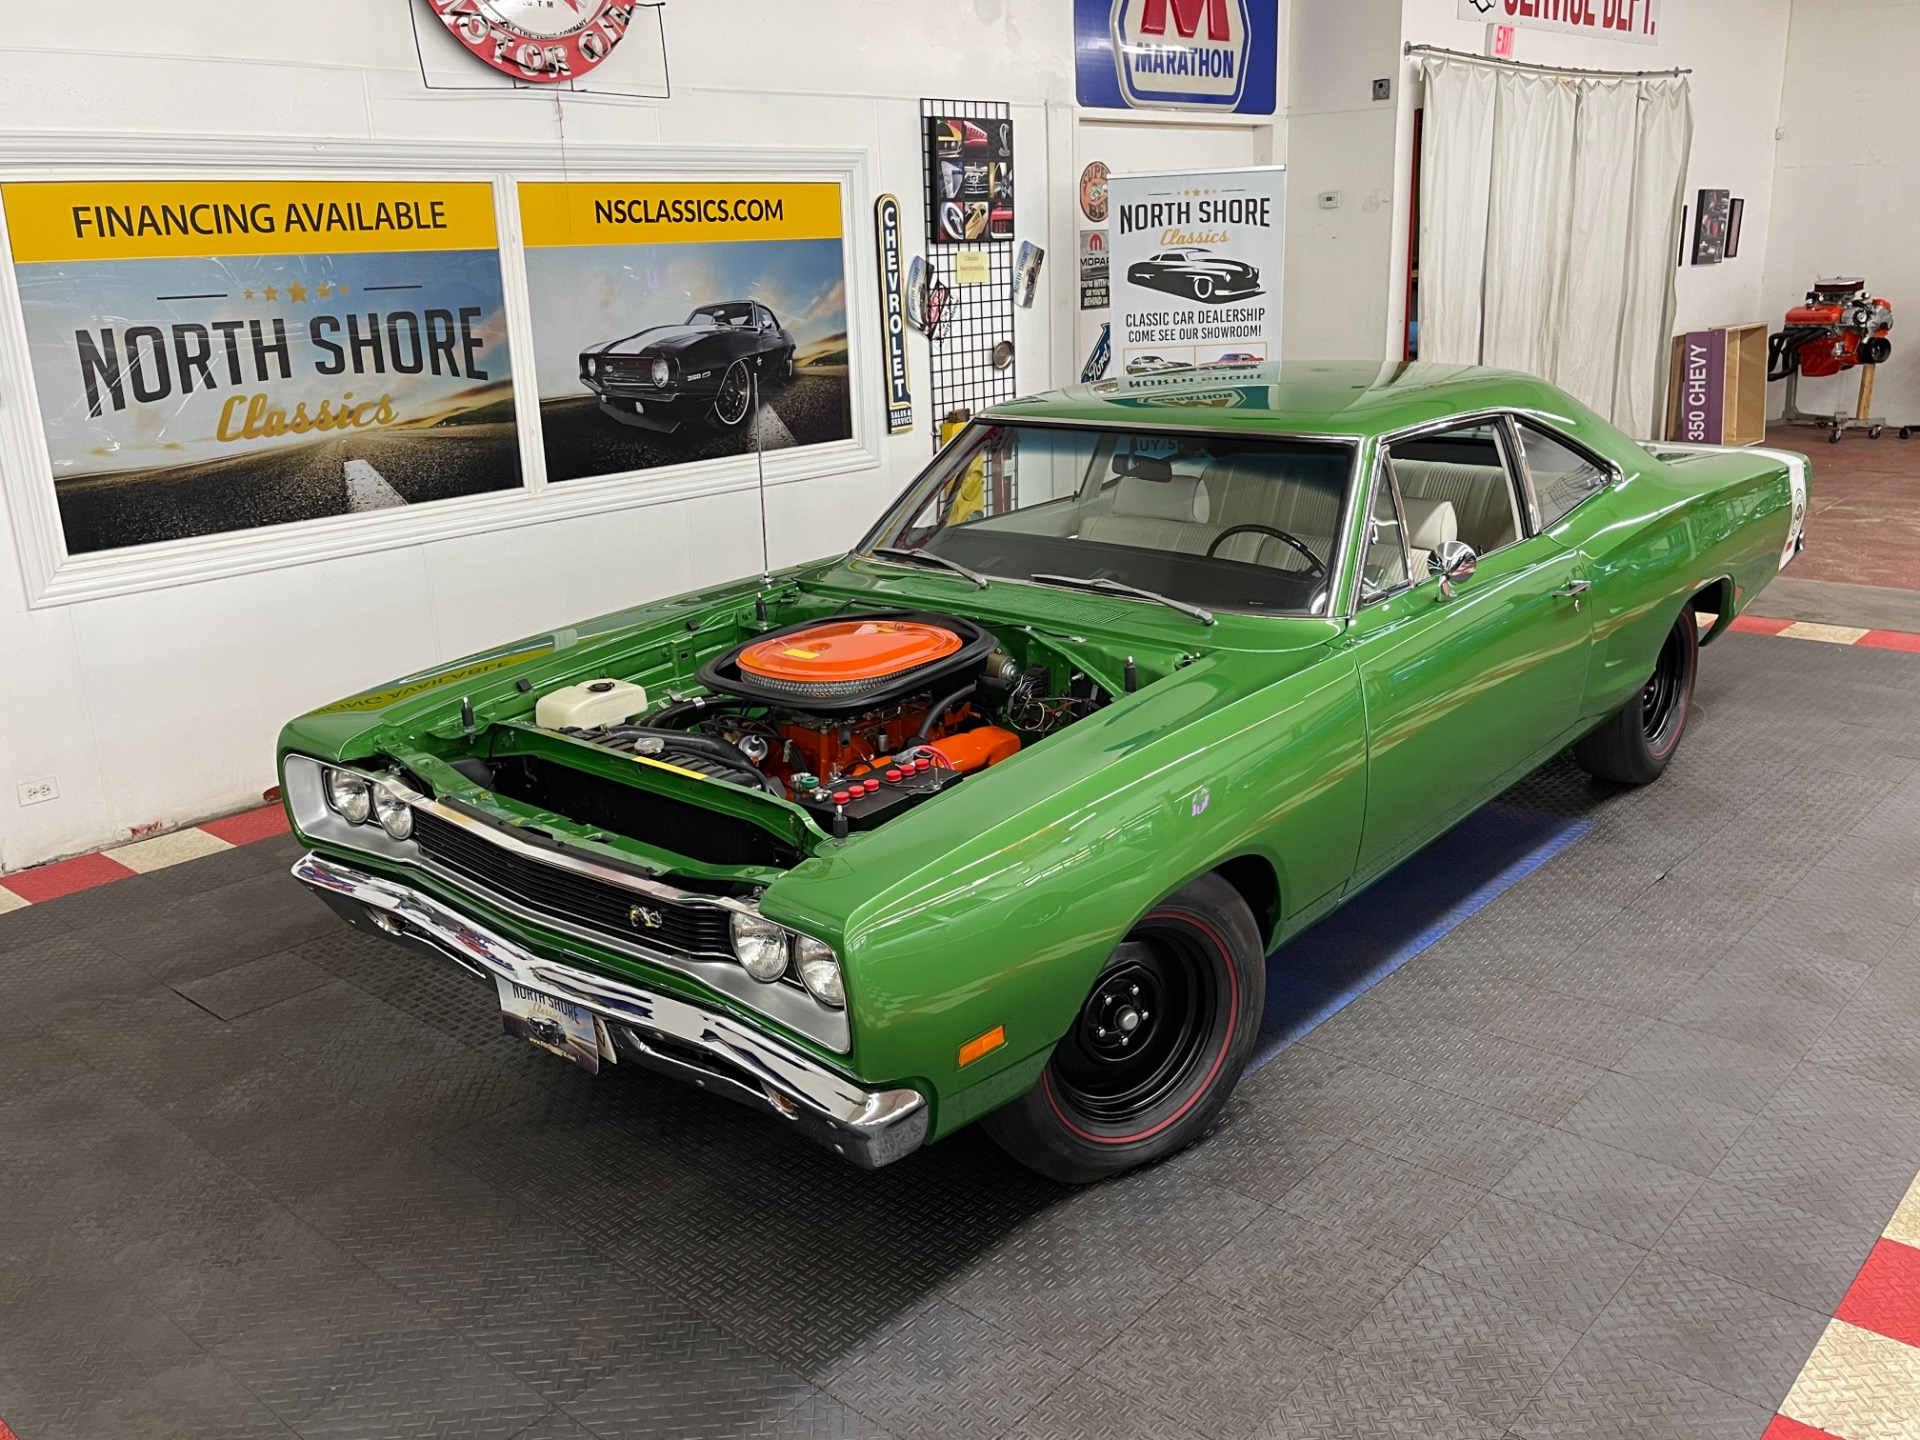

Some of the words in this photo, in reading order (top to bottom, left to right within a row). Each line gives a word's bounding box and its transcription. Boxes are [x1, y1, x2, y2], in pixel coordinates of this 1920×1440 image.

[578, 4, 636, 63] OIL
[1135, 42, 1234, 78] MARATHON
[1083, 163, 1107, 185] SUPE
[72, 203, 276, 239] FINANCING
[284, 201, 448, 233] AVAILABLE
[594, 199, 784, 224] NSCLASSICS.COM
[1120, 201, 1191, 235] NORTH
[1199, 197, 1271, 228] SHORE
[1160, 228, 1230, 246] Classics
[884, 206, 905, 398] CHEVROLET
[1126, 311, 1169, 328] CLASSIC
[1173, 311, 1195, 326] CAR
[1198, 308, 1266, 324] DEALERSHIP
[1128, 328, 1156, 342] COME
[1158, 328, 1176, 341] SEE
[1179, 327, 1199, 340] OUR
[1201, 324, 1262, 339] SHOWROOM!
[75, 318, 293, 419] NORTH
[309, 306, 489, 381] SHORE
[1688, 344, 1708, 407] CHEVY
[216, 392, 400, 443] Classics
[1687, 411, 1706, 441] 350
[512, 983, 546, 1005] NORTH
[548, 997, 580, 1025] SHORE
